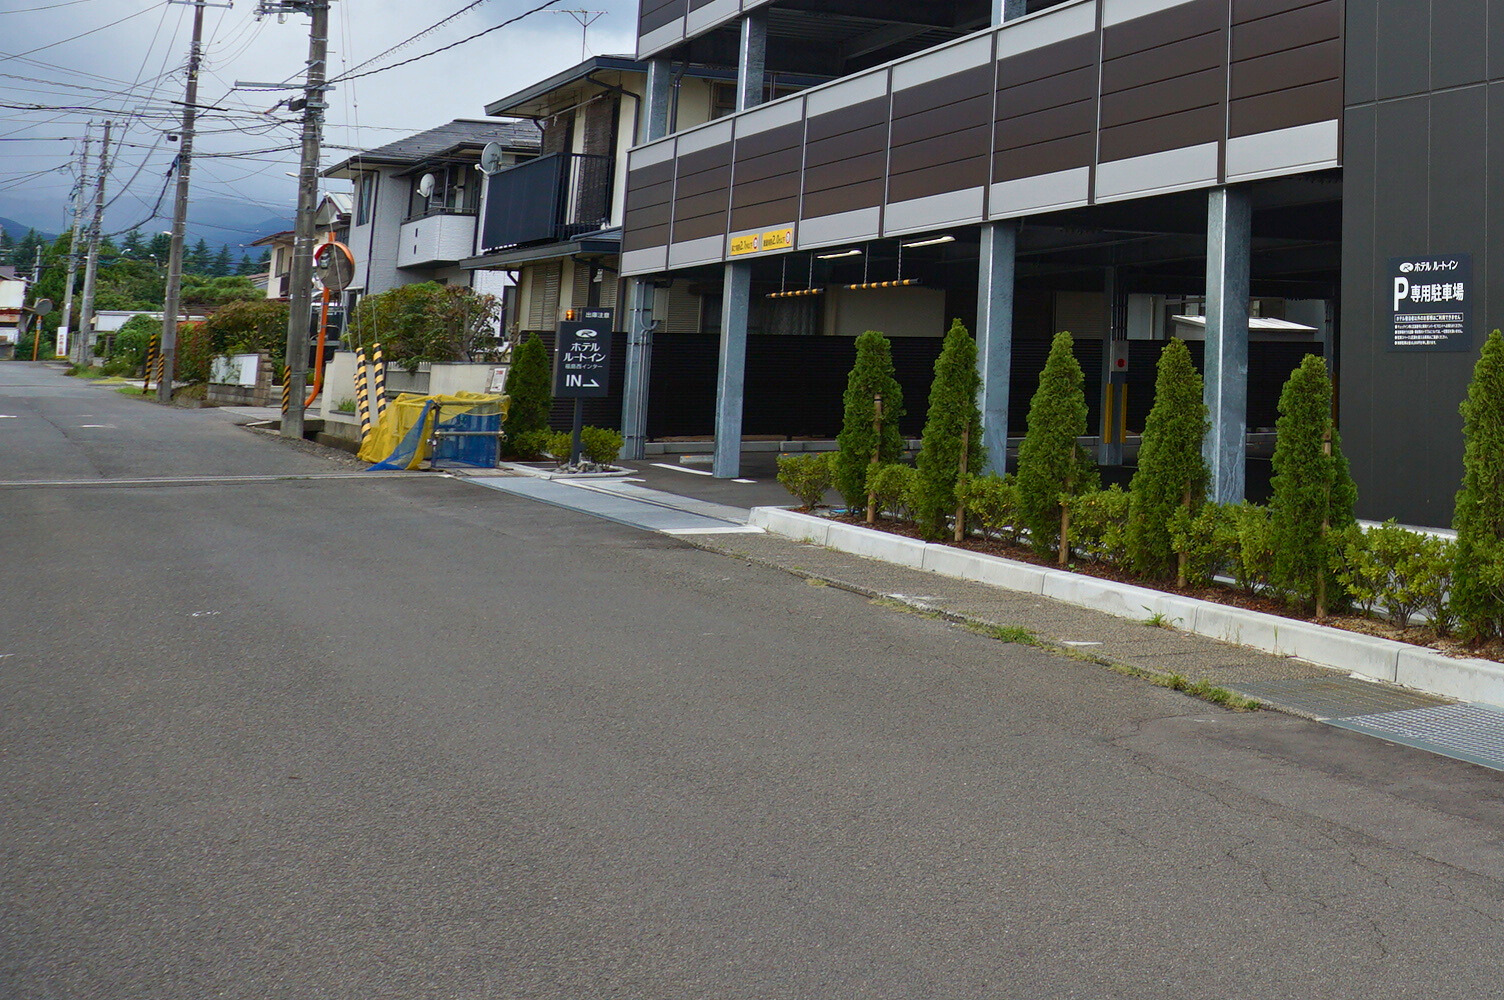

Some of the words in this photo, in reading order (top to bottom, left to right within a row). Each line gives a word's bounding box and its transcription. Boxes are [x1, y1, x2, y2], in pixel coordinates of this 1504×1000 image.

[1413, 261, 1431, 272] ホテル
[1432, 260, 1459, 271] ルートイン
[1393, 276, 1409, 312] P
[1410, 282, 1464, 303] 専用駐車場
[570, 342, 601, 352] ホテル
[563, 352, 607, 362] ルートイン
[565, 374, 582, 387] IN
